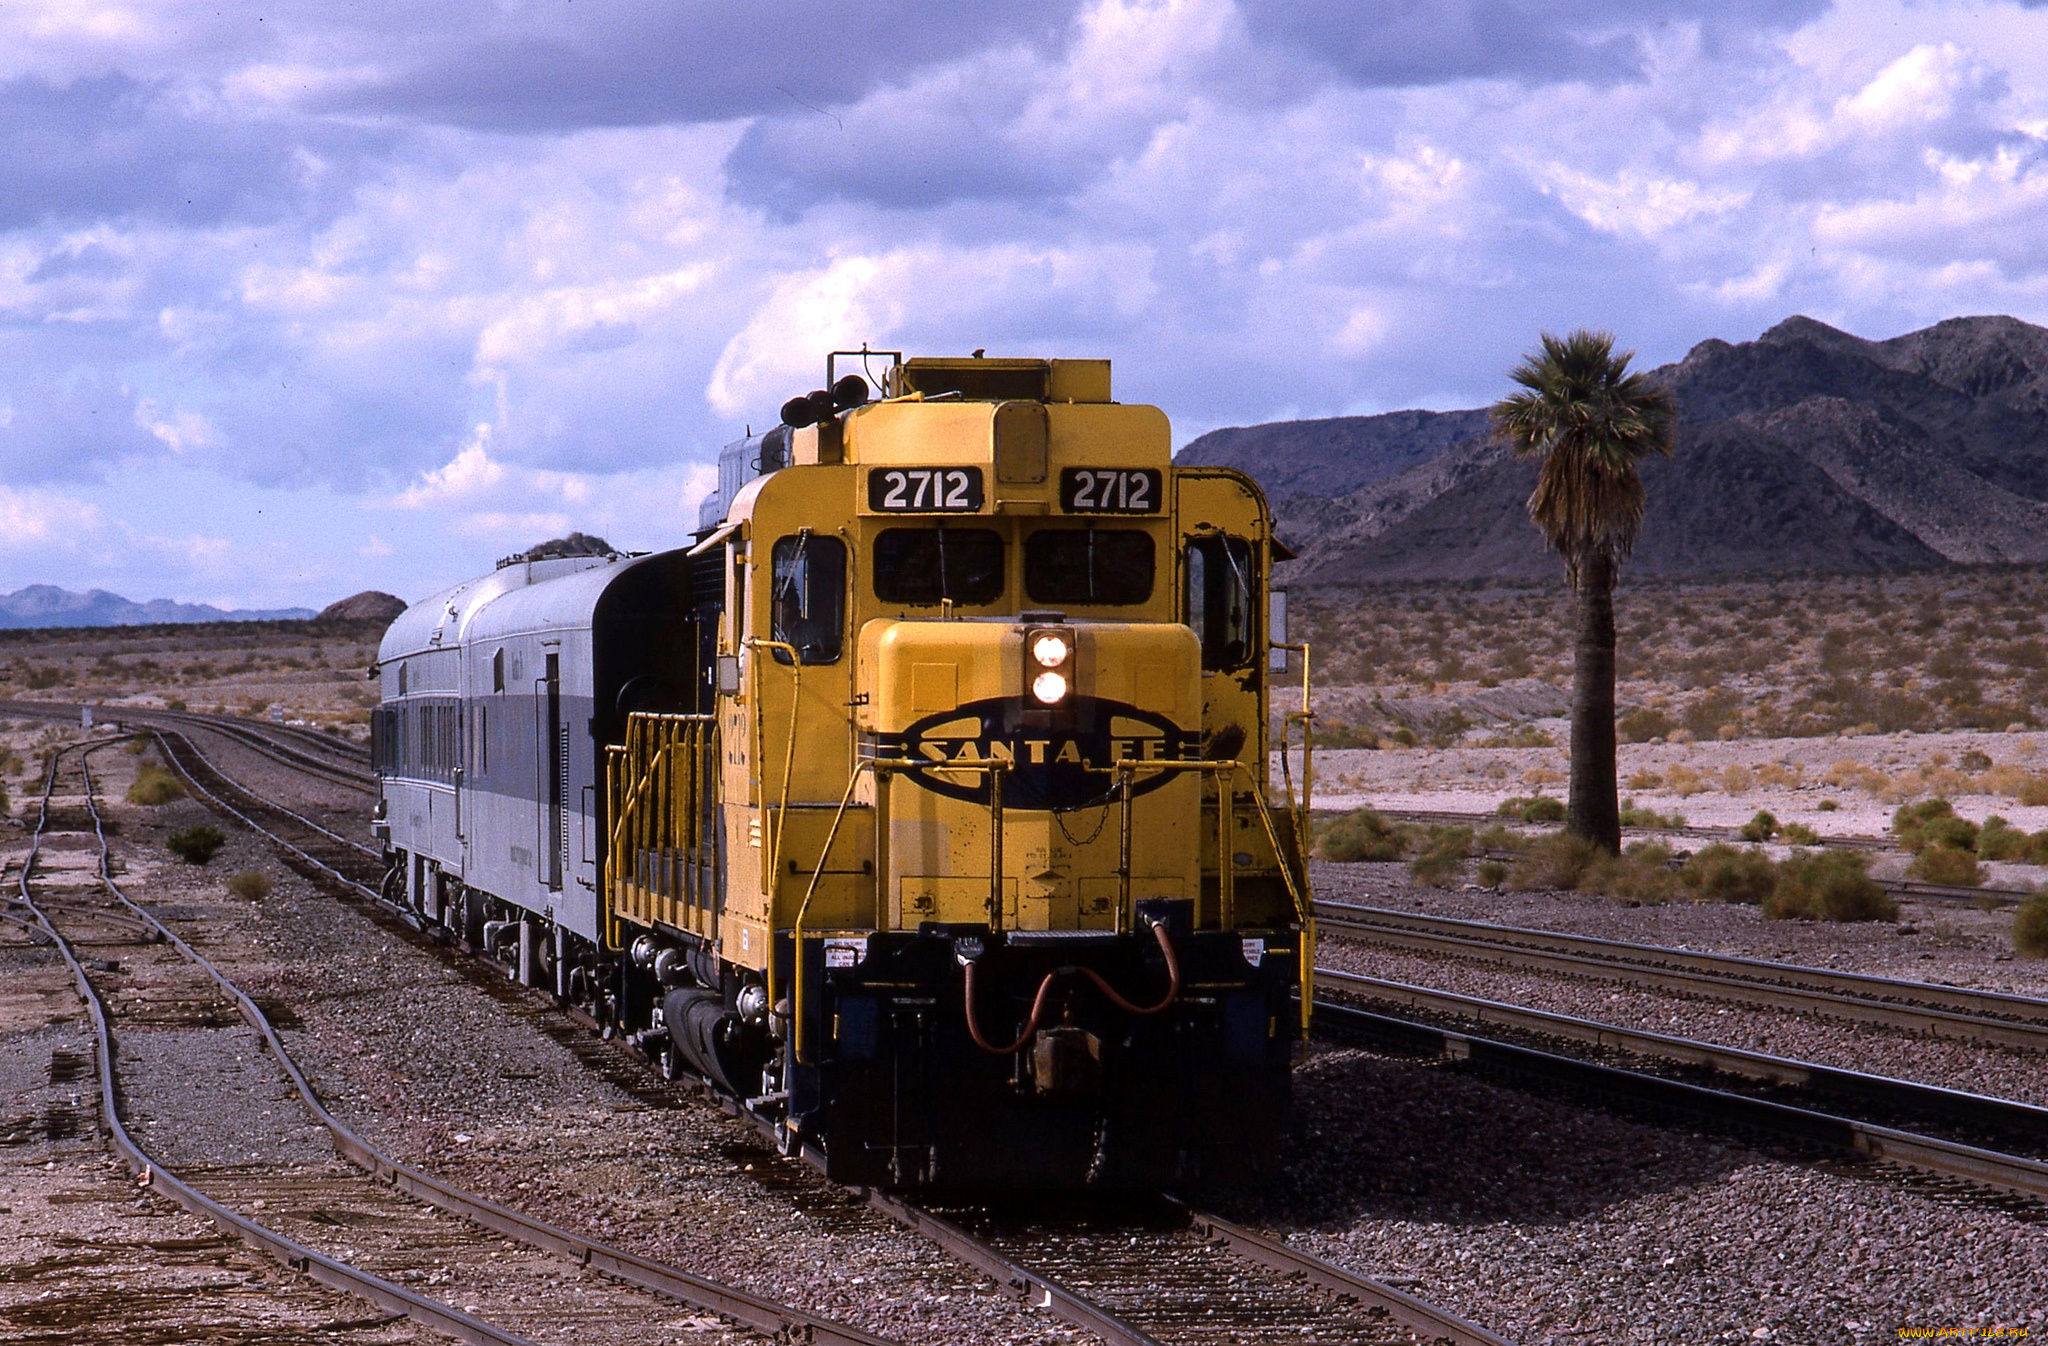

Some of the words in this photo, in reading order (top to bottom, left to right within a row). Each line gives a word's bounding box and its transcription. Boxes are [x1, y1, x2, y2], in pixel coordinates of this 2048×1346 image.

[884, 471, 969, 508] 2712
[1073, 471, 1151, 509] 2712
[918, 740, 1081, 763] SANTA
[1110, 740, 1167, 763] FE
